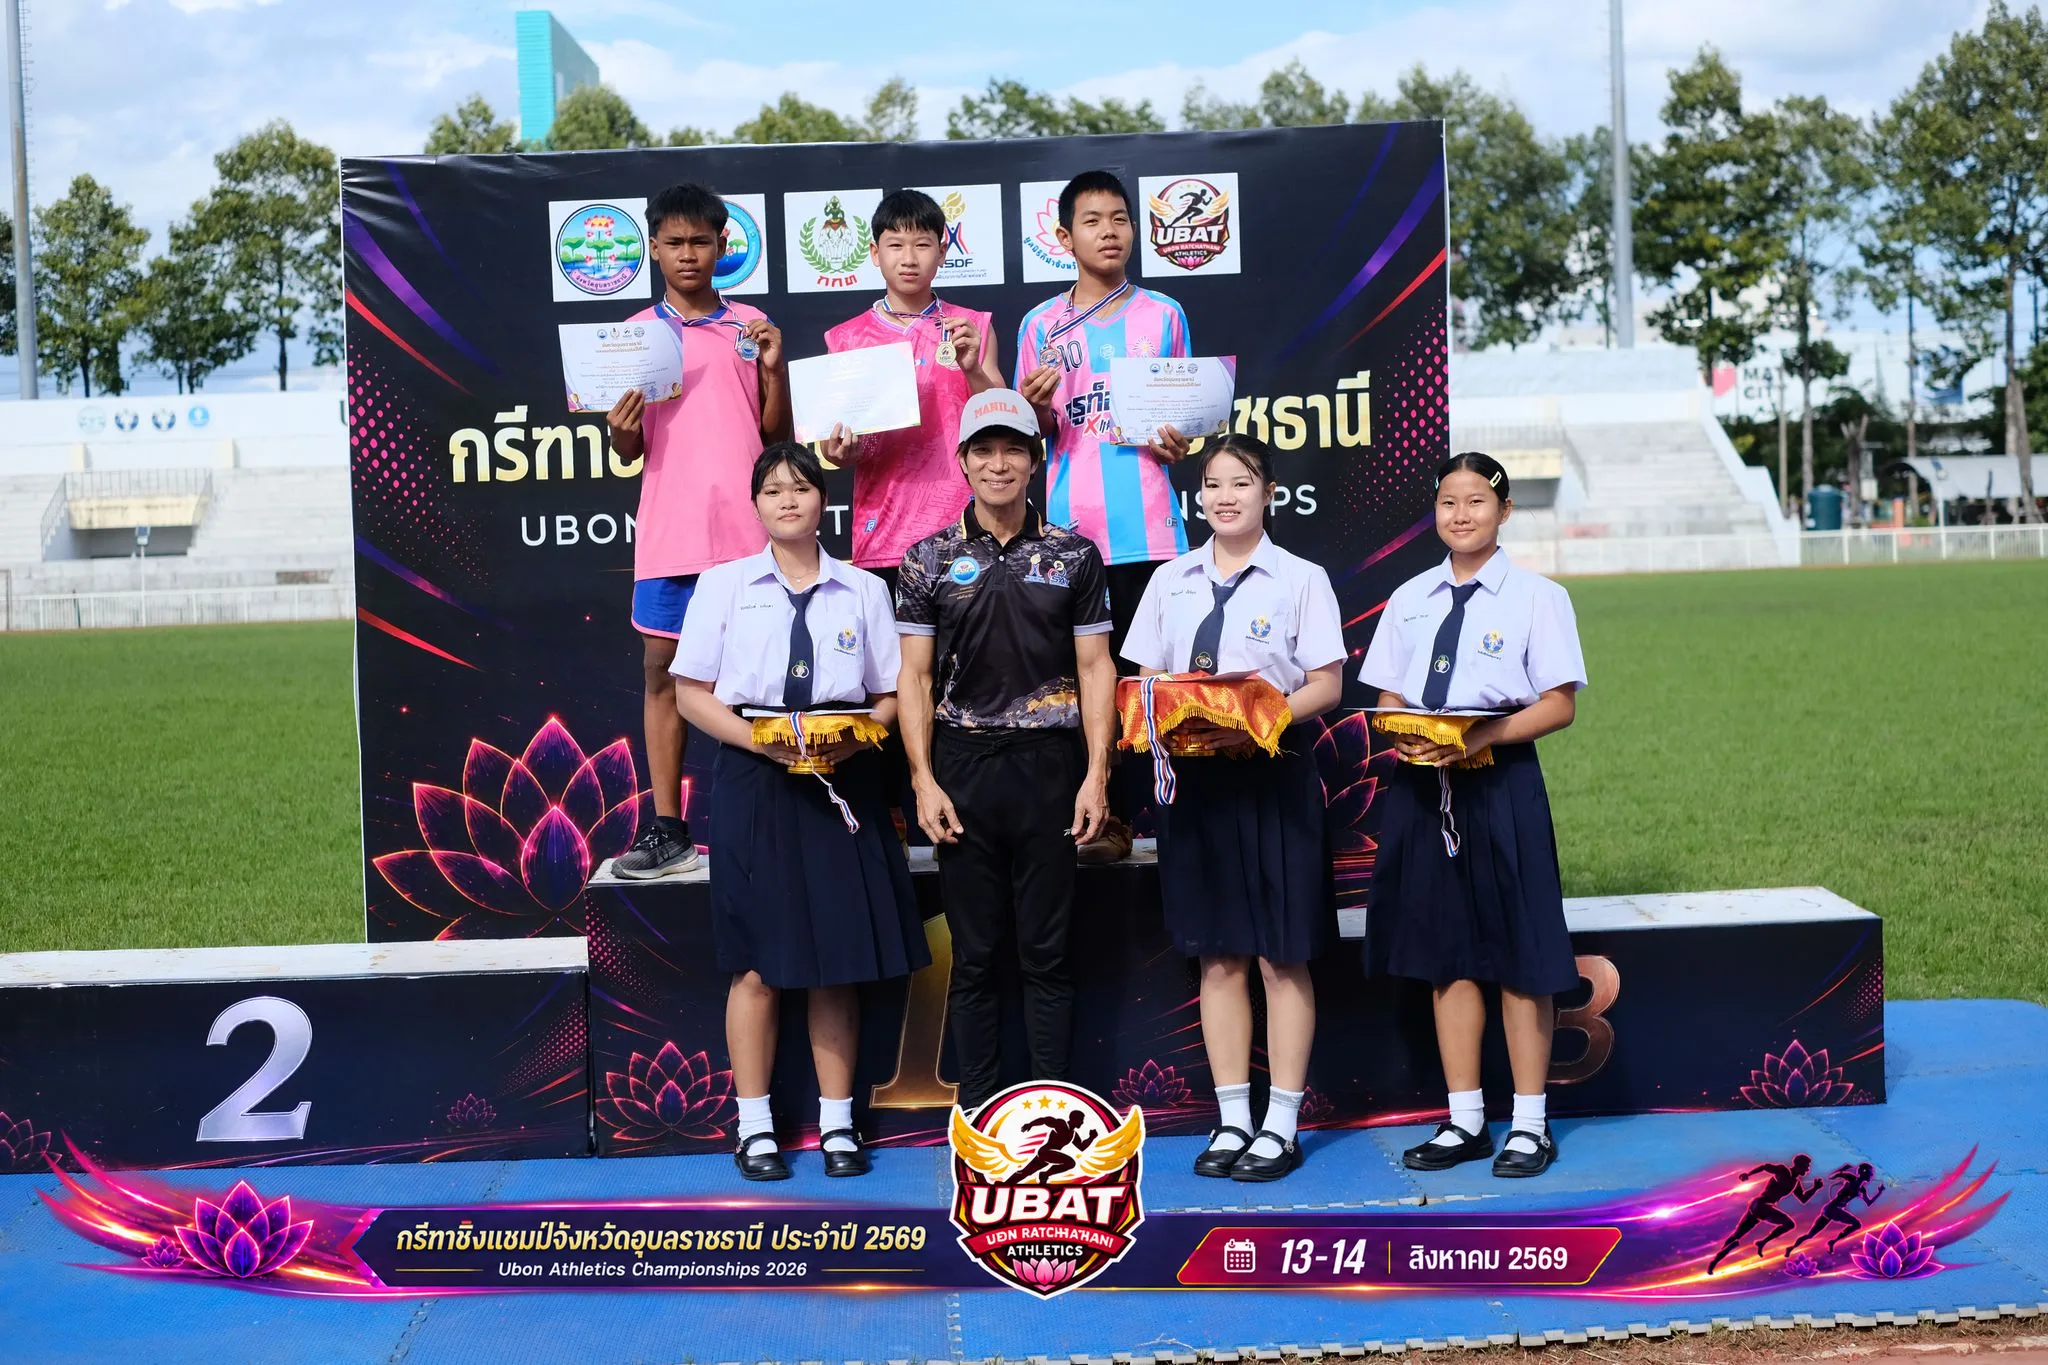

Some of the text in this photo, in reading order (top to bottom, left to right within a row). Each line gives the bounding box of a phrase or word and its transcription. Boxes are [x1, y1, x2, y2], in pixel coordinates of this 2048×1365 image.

[1156, 225, 1223, 245] UBAT
[940, 258, 973, 268] SDF
[1023, 236, 1076, 270] มูลนิธิกีฬาจังหวั
[817, 274, 858, 287] กกท
[1056, 340, 1083, 373] 10
[974, 401, 1019, 418] MANILA
[869, 912, 960, 1108] 1
[1545, 954, 1621, 1084] 3
[196, 995, 313, 1142] 2
